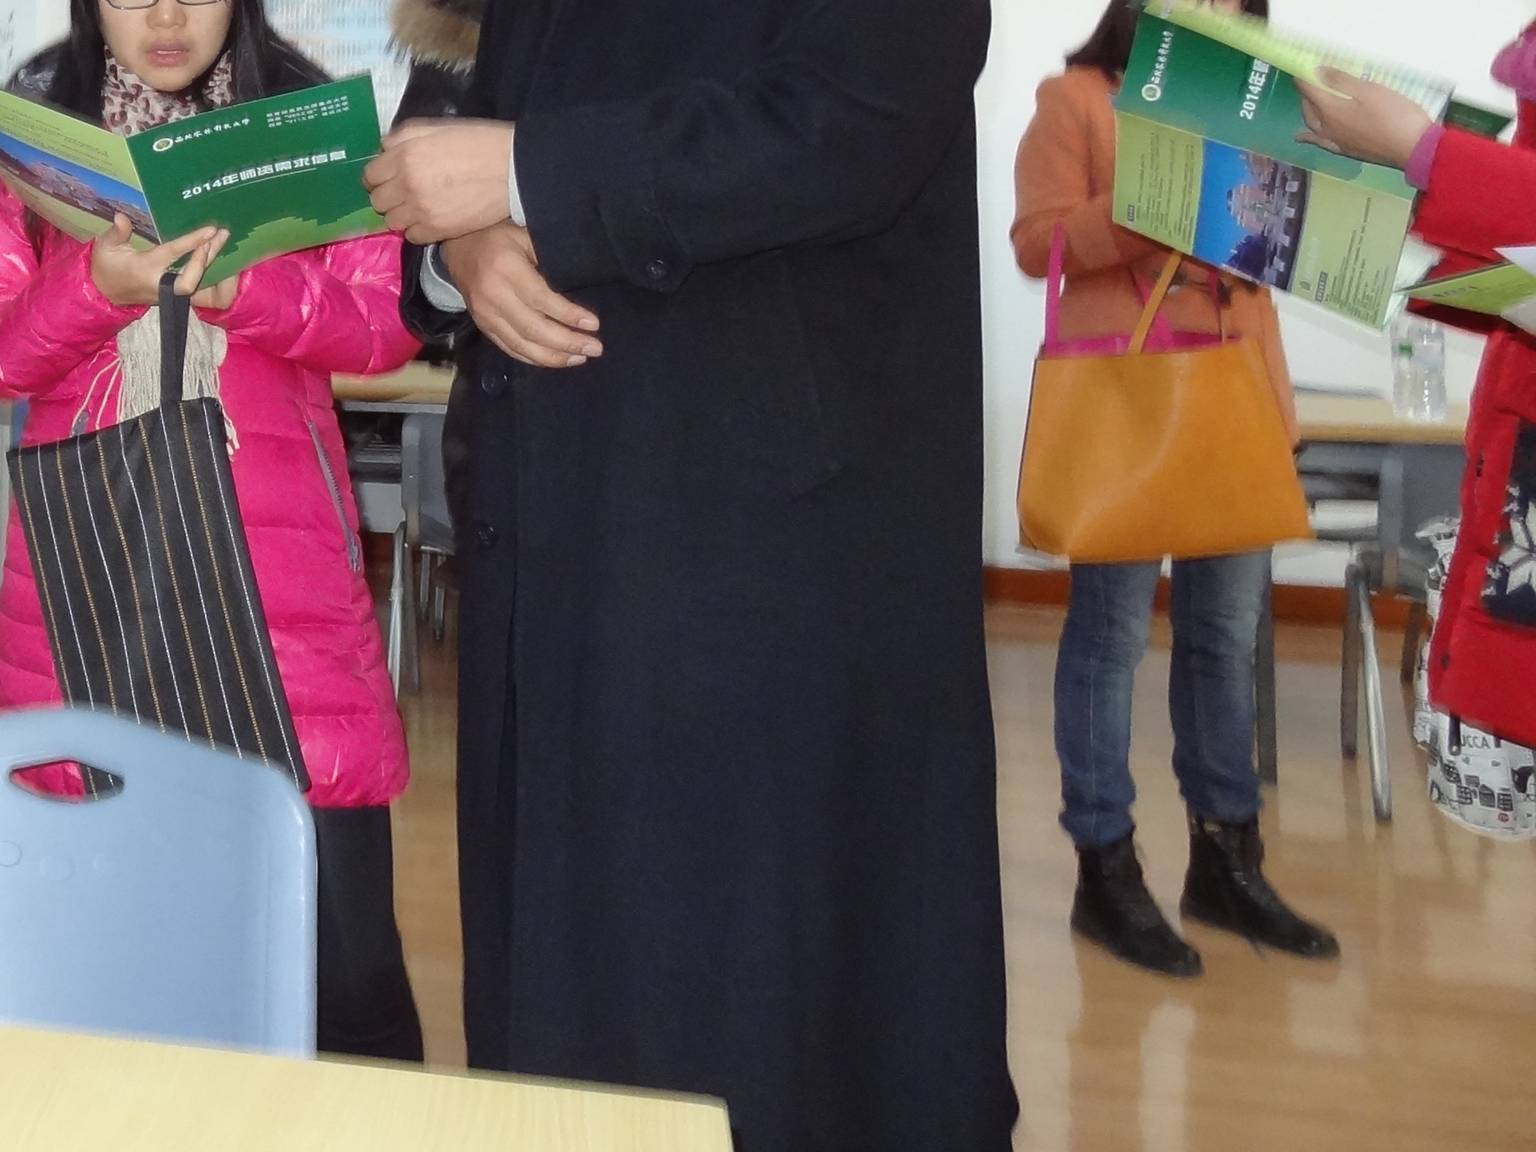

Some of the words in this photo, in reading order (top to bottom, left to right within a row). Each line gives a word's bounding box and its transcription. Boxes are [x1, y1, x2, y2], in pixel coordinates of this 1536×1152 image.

[182, 149, 347, 199] 2014年师资需求信息
